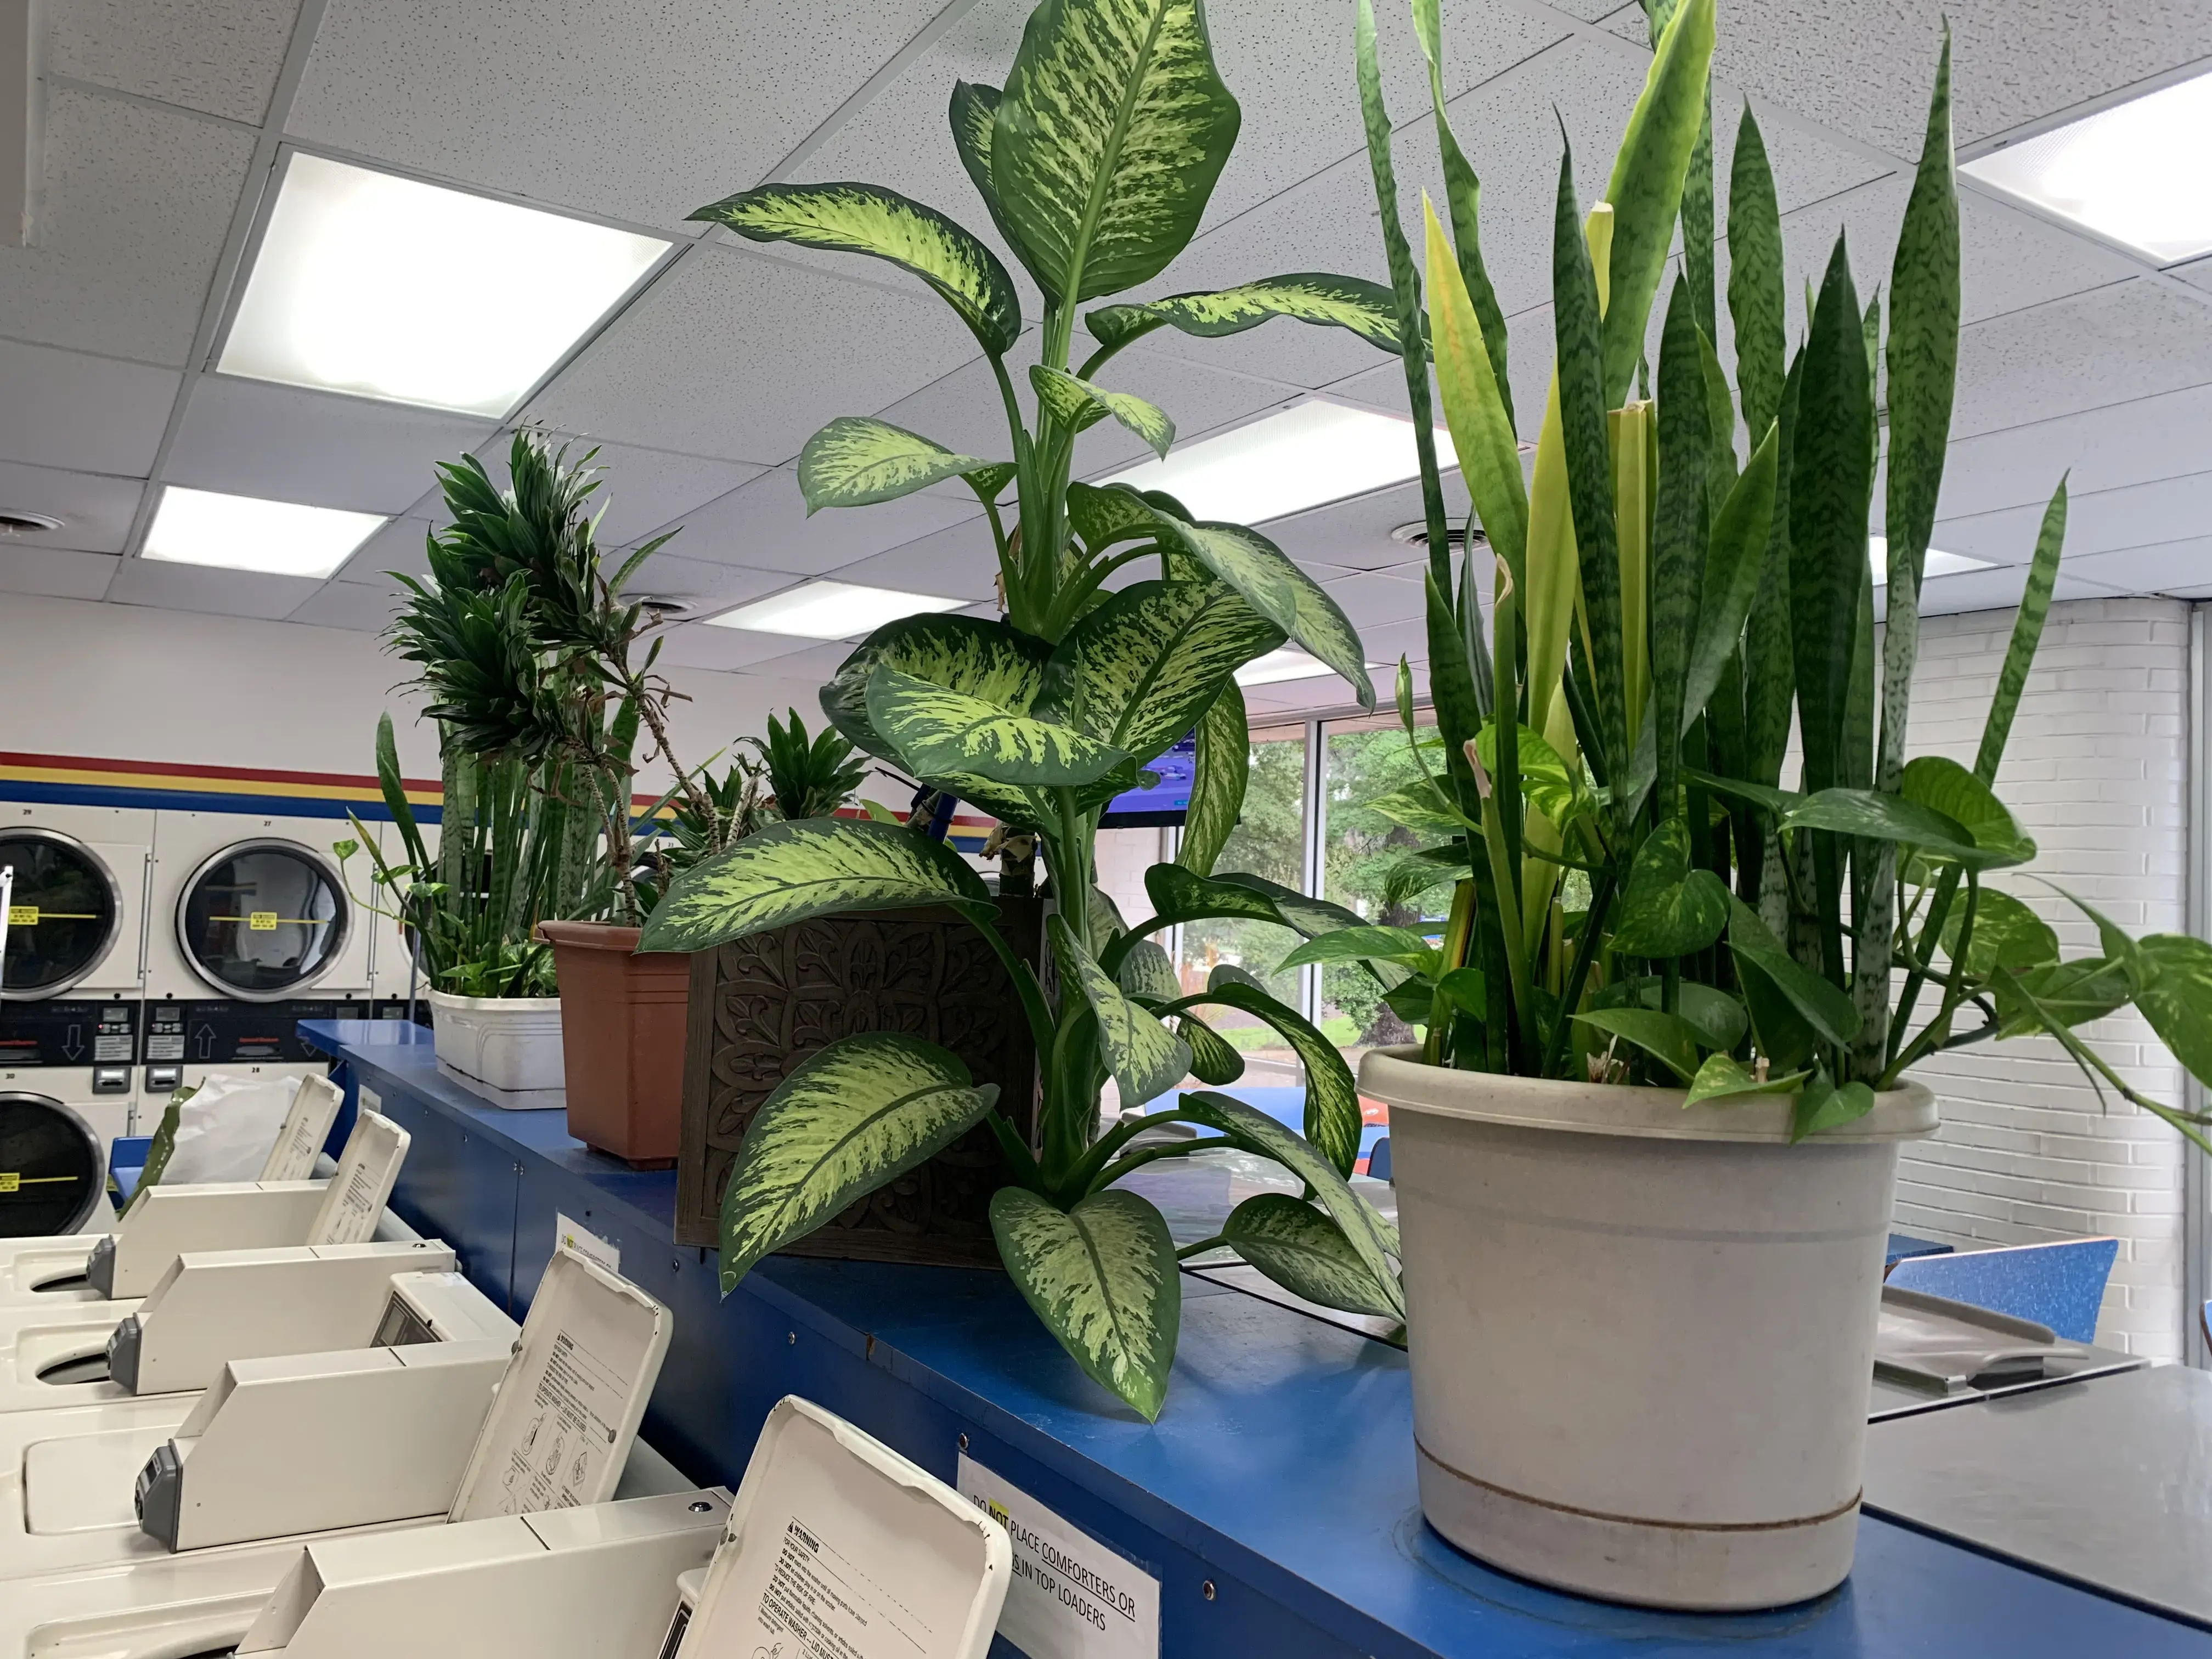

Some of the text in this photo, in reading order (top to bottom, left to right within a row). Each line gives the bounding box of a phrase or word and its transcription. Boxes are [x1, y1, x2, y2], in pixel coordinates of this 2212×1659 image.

[794, 1525, 819, 1553] WARNING
[974, 1495, 986, 1513] DO
[989, 1505, 1008, 1530] NOT
[1011, 1520, 1039, 1553] PLACE
[1042, 1542, 1115, 1603] COMFORTERS
[1119, 1592, 1135, 1617] OR
[778, 1567, 791, 1582] REDUCE
[1022, 1559, 1032, 1579] IN
[1035, 1567, 1056, 1593] TOP
[1058, 1584, 1105, 1630] LOADERS
[763, 1593, 769, 1604] TO
[769, 1599, 789, 1622] OPERATE
[788, 1616, 807, 1640] WASHER
[811, 1640, 820, 1652] LID
[819, 1647, 833, 1659] MUS
